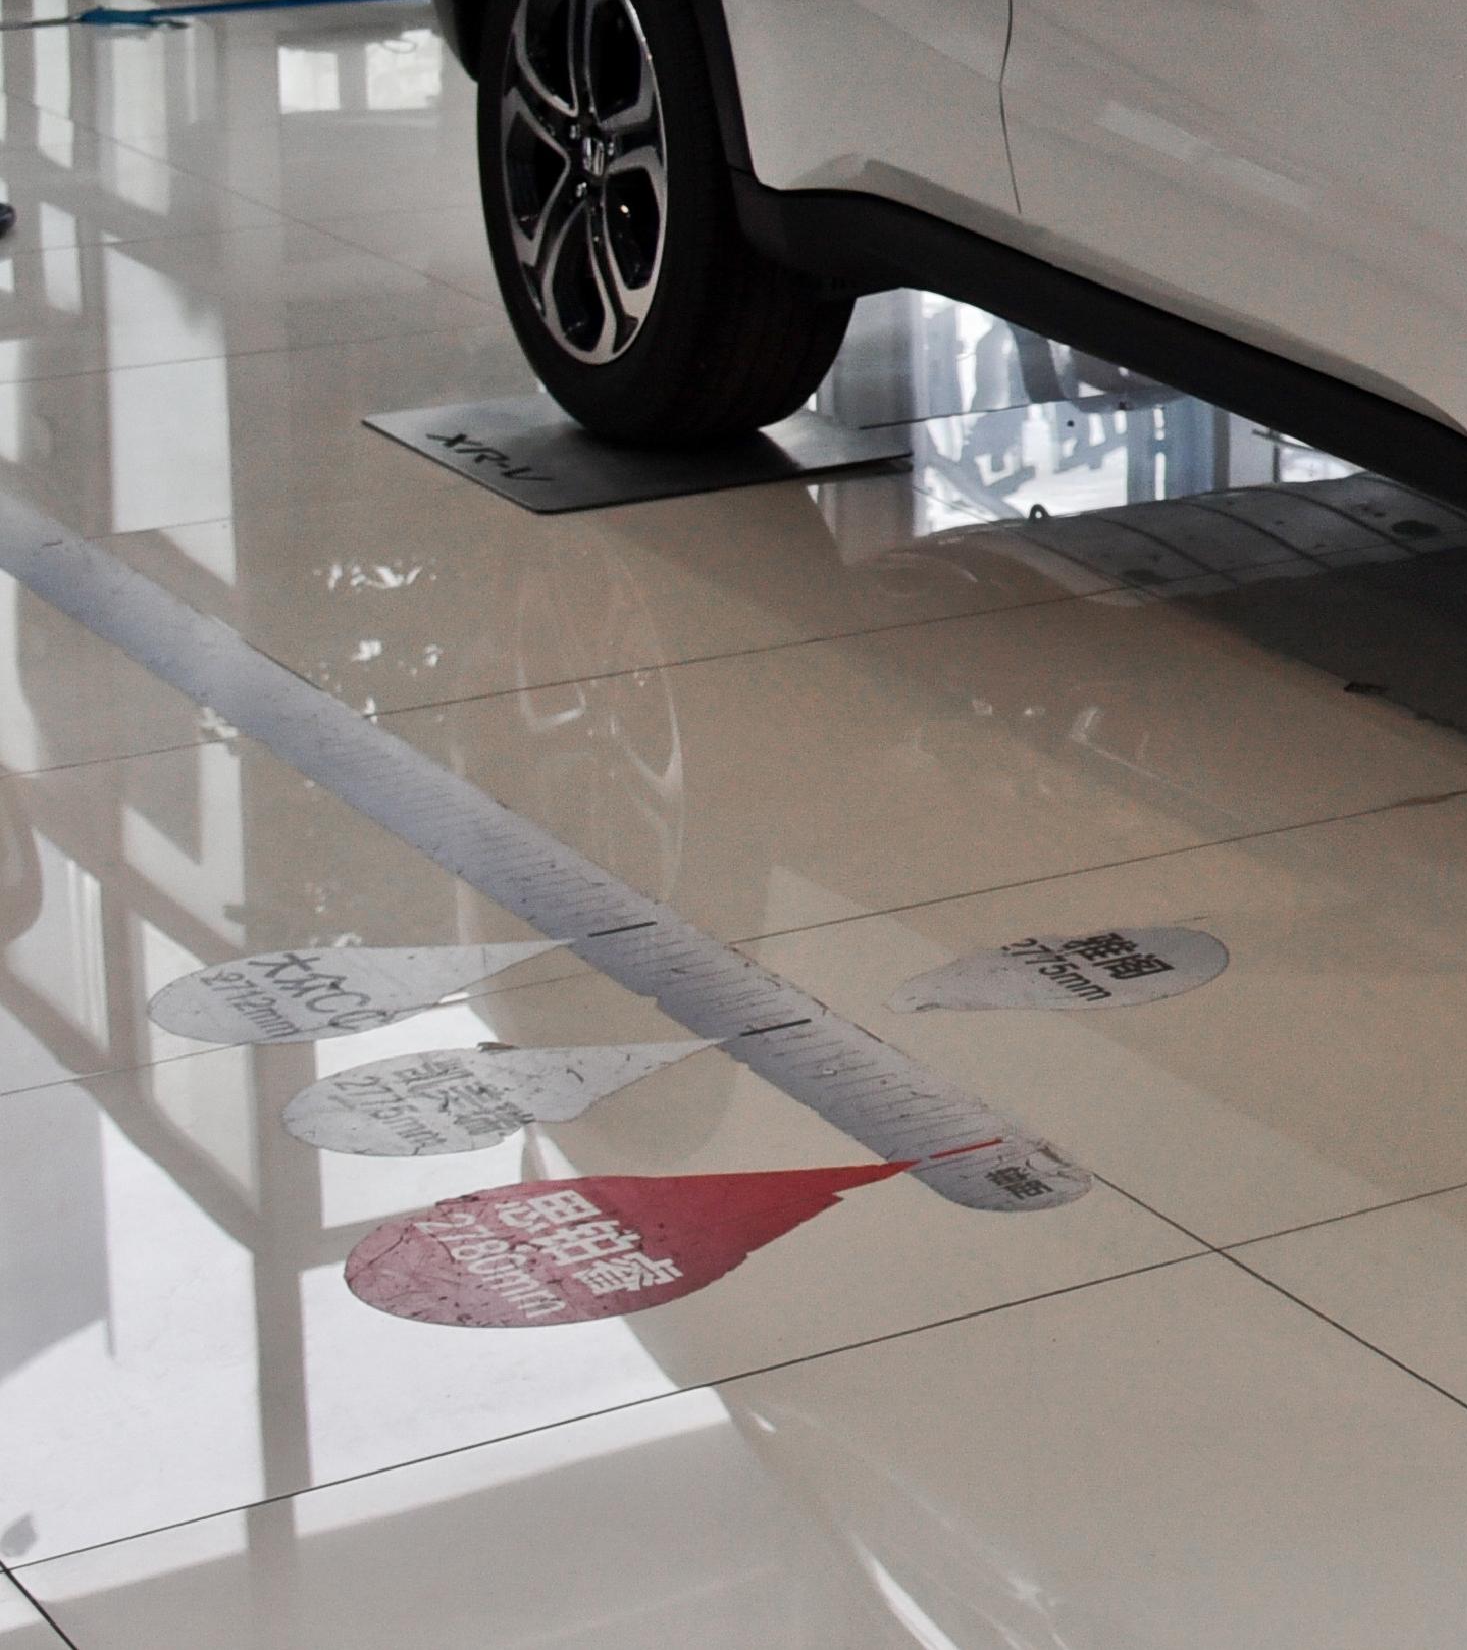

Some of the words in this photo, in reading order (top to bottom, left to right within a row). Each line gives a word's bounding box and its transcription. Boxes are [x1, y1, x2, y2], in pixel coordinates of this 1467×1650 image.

[425, 431, 554, 483] XR-V
[1061, 932, 1177, 981] 雅阁
[415, 1211, 568, 1320] 2780mm
[496, 1188, 684, 1296] 思铂睿
